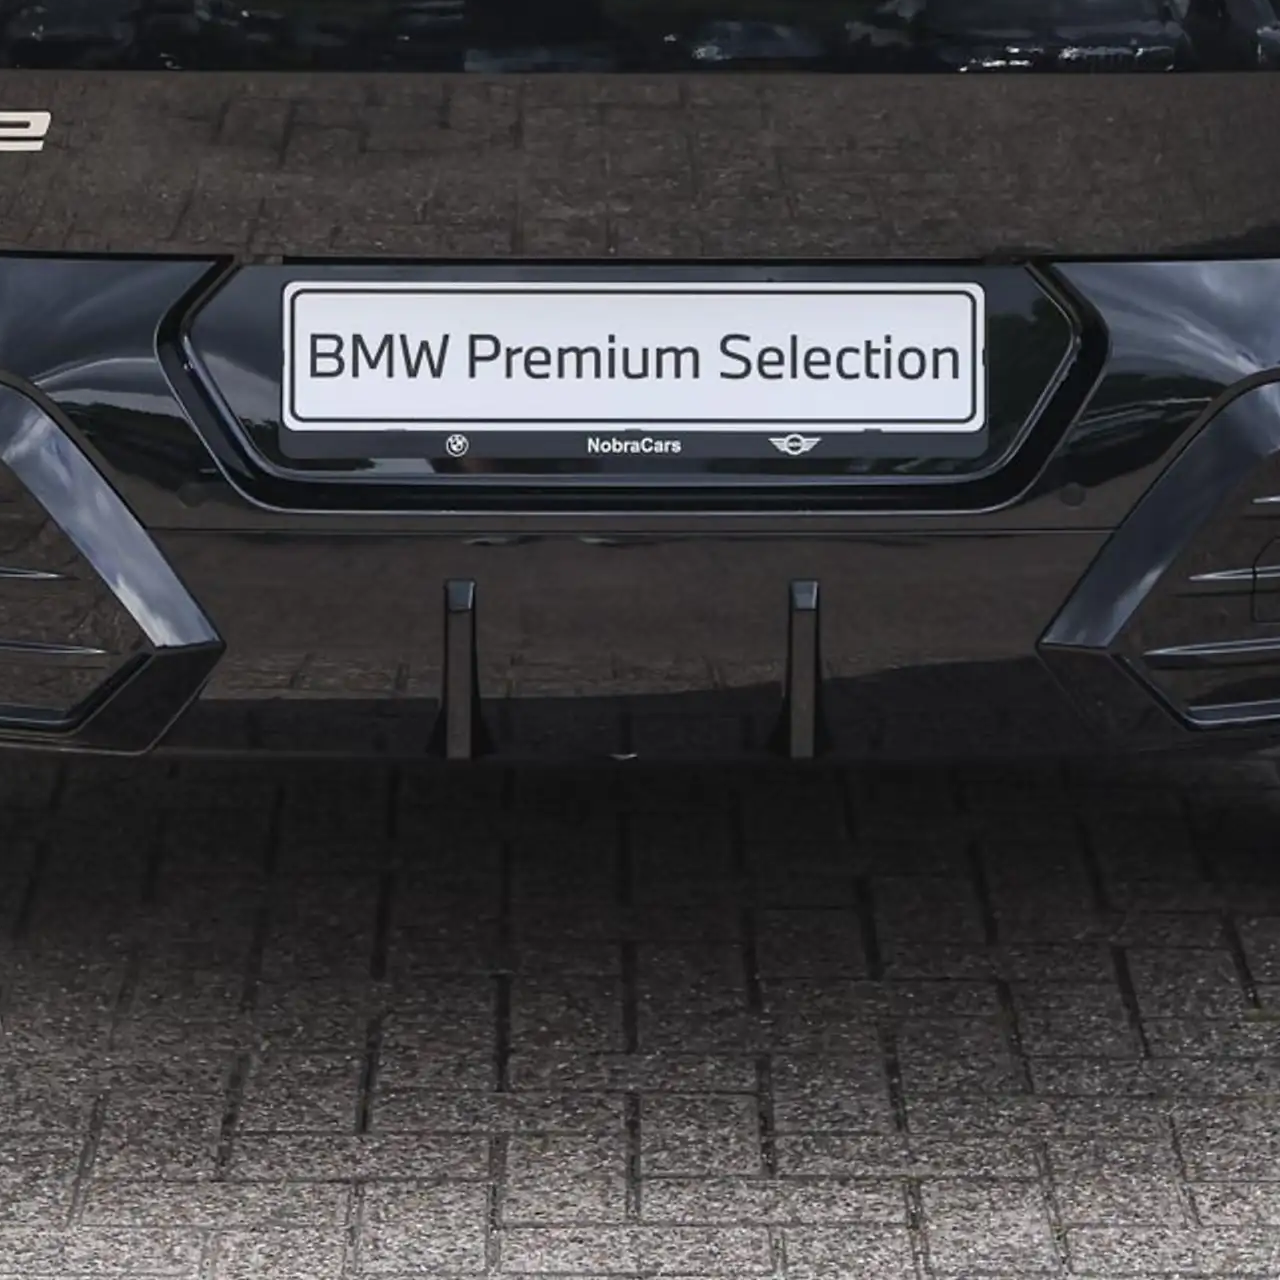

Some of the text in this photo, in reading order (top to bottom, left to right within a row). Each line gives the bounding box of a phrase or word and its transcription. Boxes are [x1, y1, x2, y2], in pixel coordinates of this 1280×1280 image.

[309, 332, 960, 380] BMW Premium Selection
[587, 437, 682, 454] NobraCars
